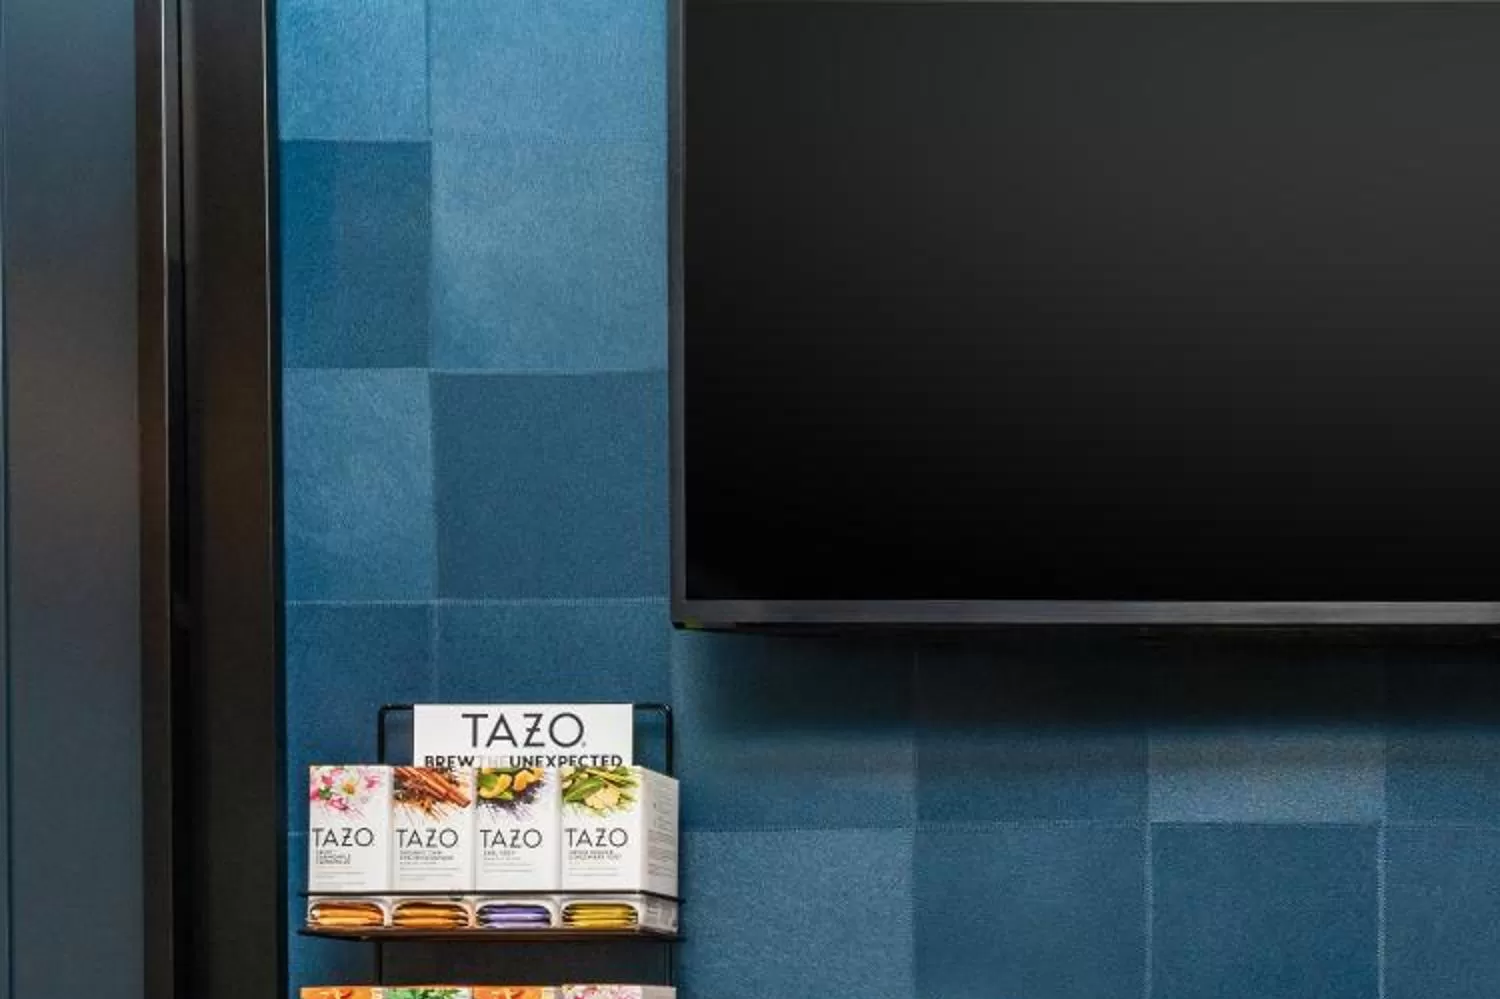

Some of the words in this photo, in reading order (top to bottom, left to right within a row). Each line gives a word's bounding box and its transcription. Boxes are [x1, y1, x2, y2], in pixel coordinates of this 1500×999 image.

[462, 712, 585, 748] TAZO
[425, 755, 475, 768] BREW
[509, 755, 623, 768] UNEXPECTED
[312, 827, 375, 847] TAZO
[396, 828, 459, 848] TAZO
[480, 828, 543, 848] TAZO
[564, 827, 629, 847] TAZO
